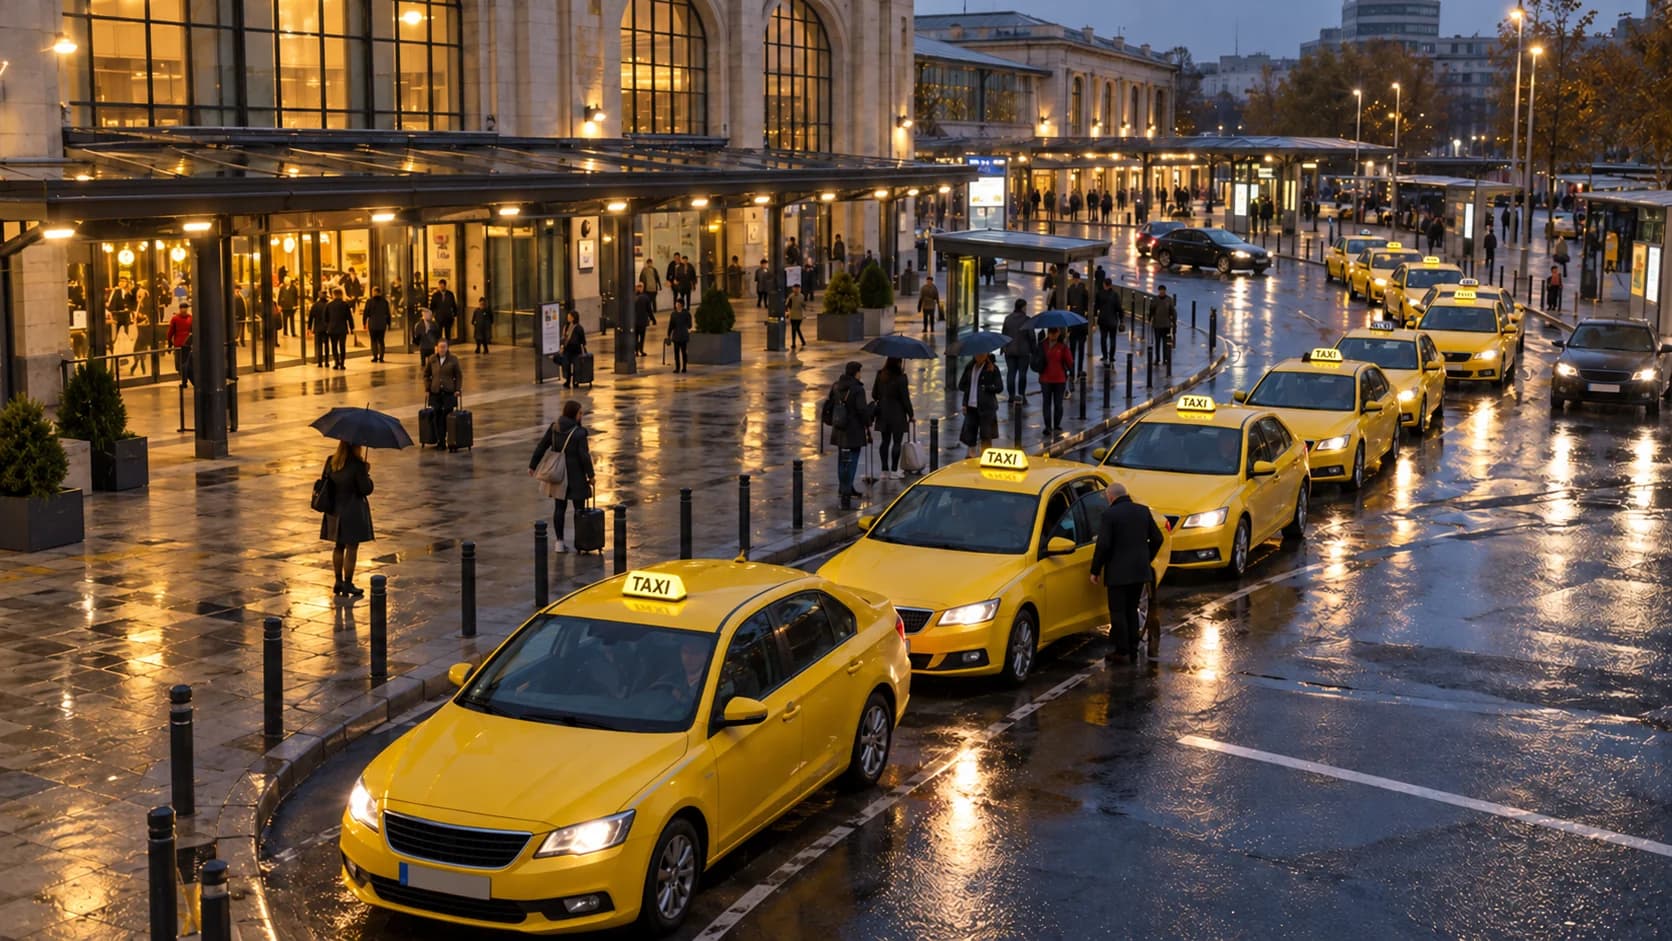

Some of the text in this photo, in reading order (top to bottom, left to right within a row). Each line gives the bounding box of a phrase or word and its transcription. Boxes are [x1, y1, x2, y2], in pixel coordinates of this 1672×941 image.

[1316, 350, 1336, 359] TAXI
[1183, 398, 1207, 408] TAXI
[988, 452, 1016, 465] TAXI
[632, 576, 671, 594] TAXI
